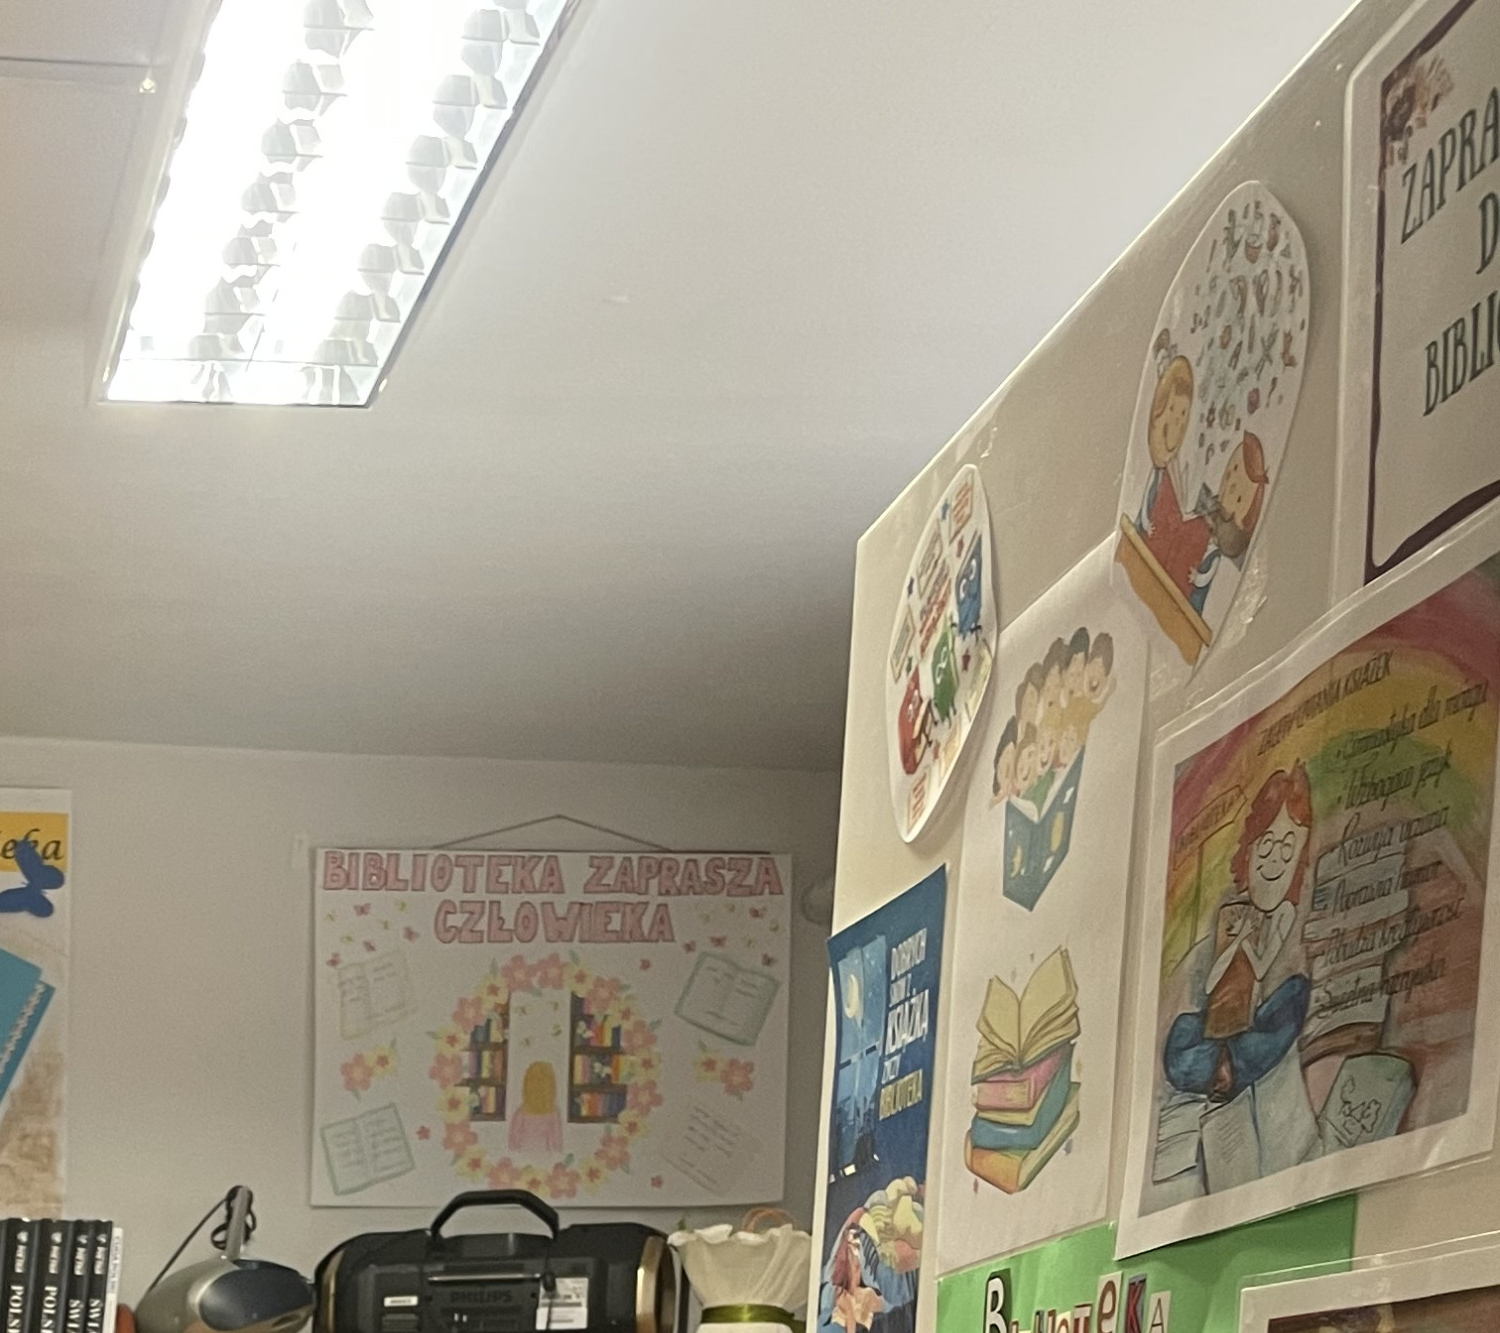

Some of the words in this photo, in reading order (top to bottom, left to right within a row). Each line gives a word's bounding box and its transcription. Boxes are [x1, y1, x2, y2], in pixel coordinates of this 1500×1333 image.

[1422, 290, 1500, 417] BIBLI
[323, 850, 565, 894] BIBLIOTEKA
[584, 856, 784, 896] ZAPRASZA
[434, 899, 675, 944] CZŁOWIEKA
